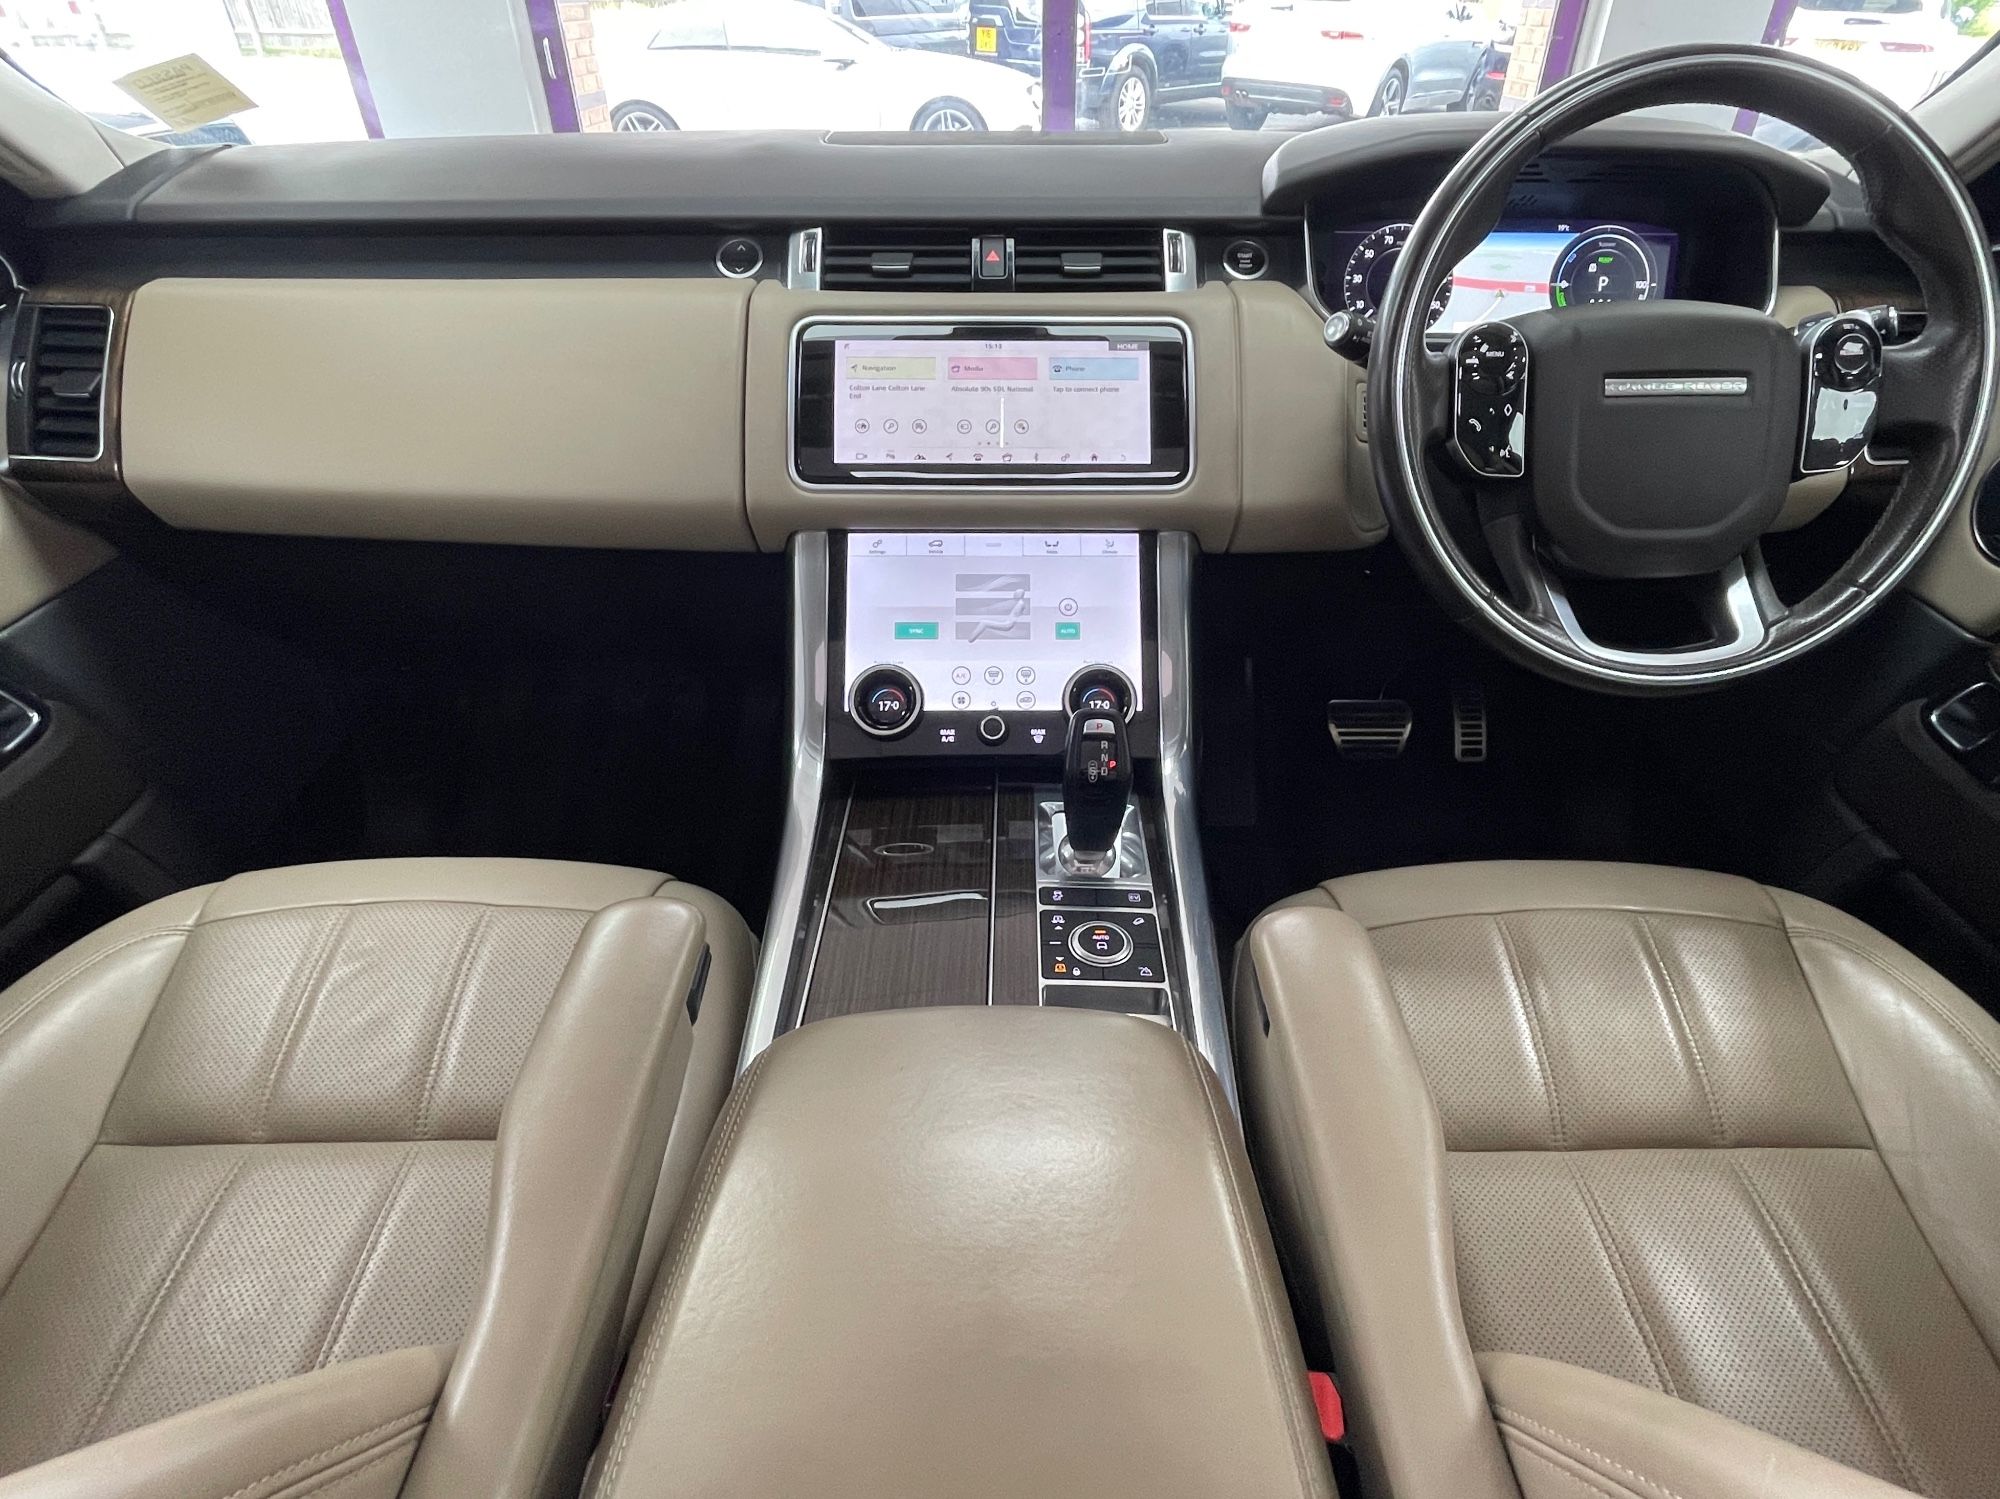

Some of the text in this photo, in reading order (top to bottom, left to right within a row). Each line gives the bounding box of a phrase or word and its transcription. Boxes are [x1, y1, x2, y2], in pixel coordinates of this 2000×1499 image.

[1384, 235, 1394, 245] 70
[1364, 249, 1374, 259] 50
[1352, 274, 1362, 284] 30
[1598, 276, 1609, 292] P
[1636, 280, 1648, 289] 100
[1356, 300, 1364, 309] 10
[862, 365, 896, 373] Navigation
[1096, 722, 1103, 730] P
[1101, 741, 1108, 749] R
[1101, 767, 1108, 776] D
